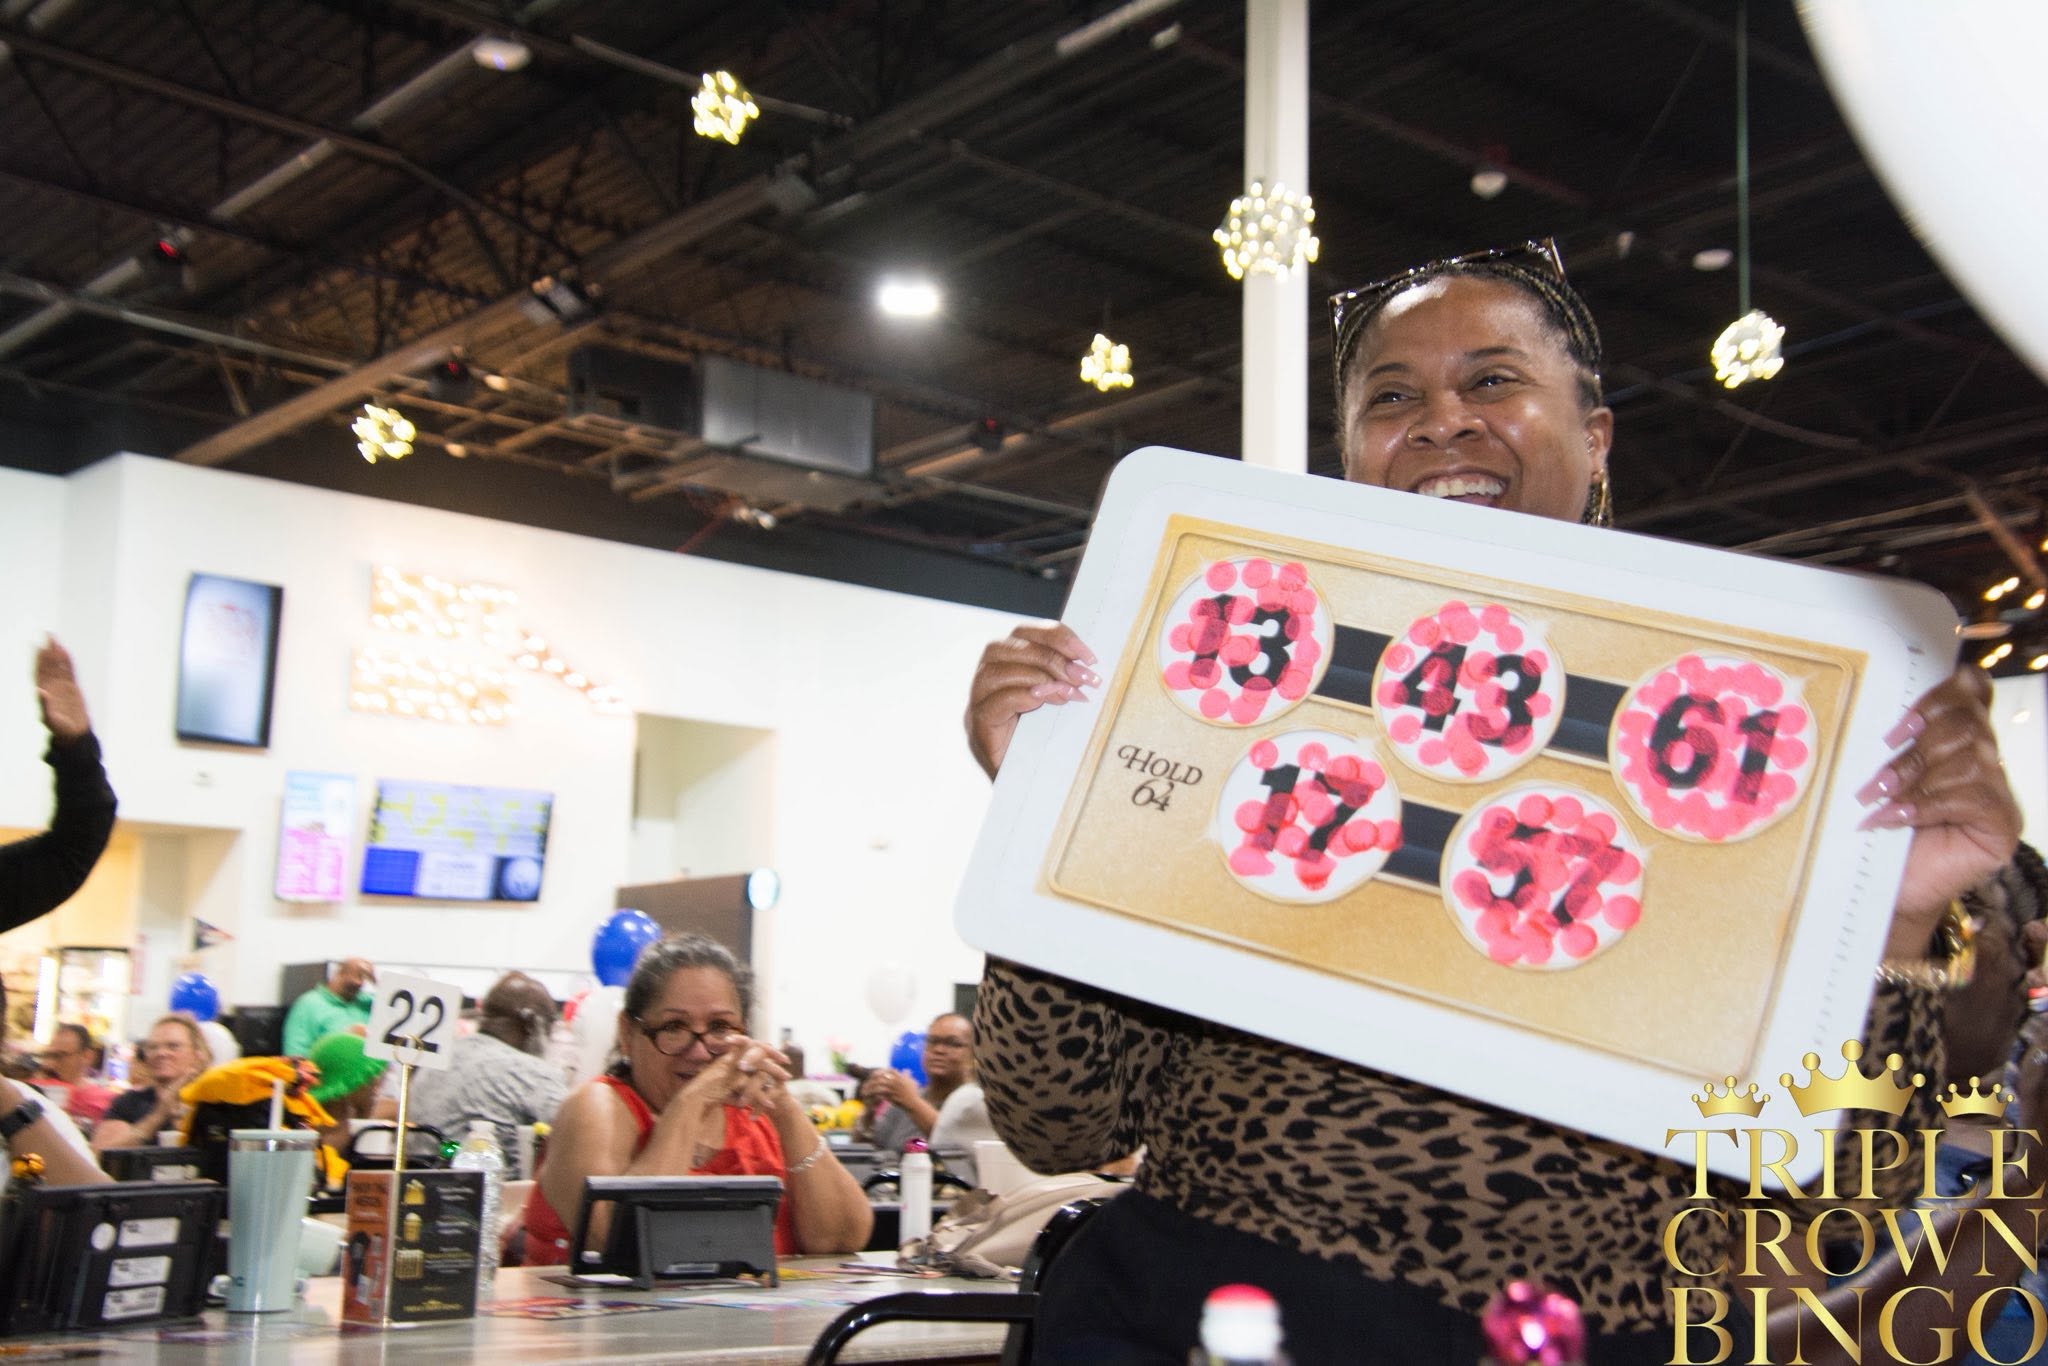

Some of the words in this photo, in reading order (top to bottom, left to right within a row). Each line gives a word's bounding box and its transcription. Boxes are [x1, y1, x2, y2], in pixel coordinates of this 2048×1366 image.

[1192, 594, 1301, 692] 13
[1395, 640, 1542, 747] 43
[1648, 693, 1781, 806] 61
[1117, 744, 1203, 786] HOLD
[1131, 778, 1175, 812] 64
[1250, 763, 1374, 863] 17
[1471, 821, 1625, 929] 57
[381, 989, 444, 1053] 22
